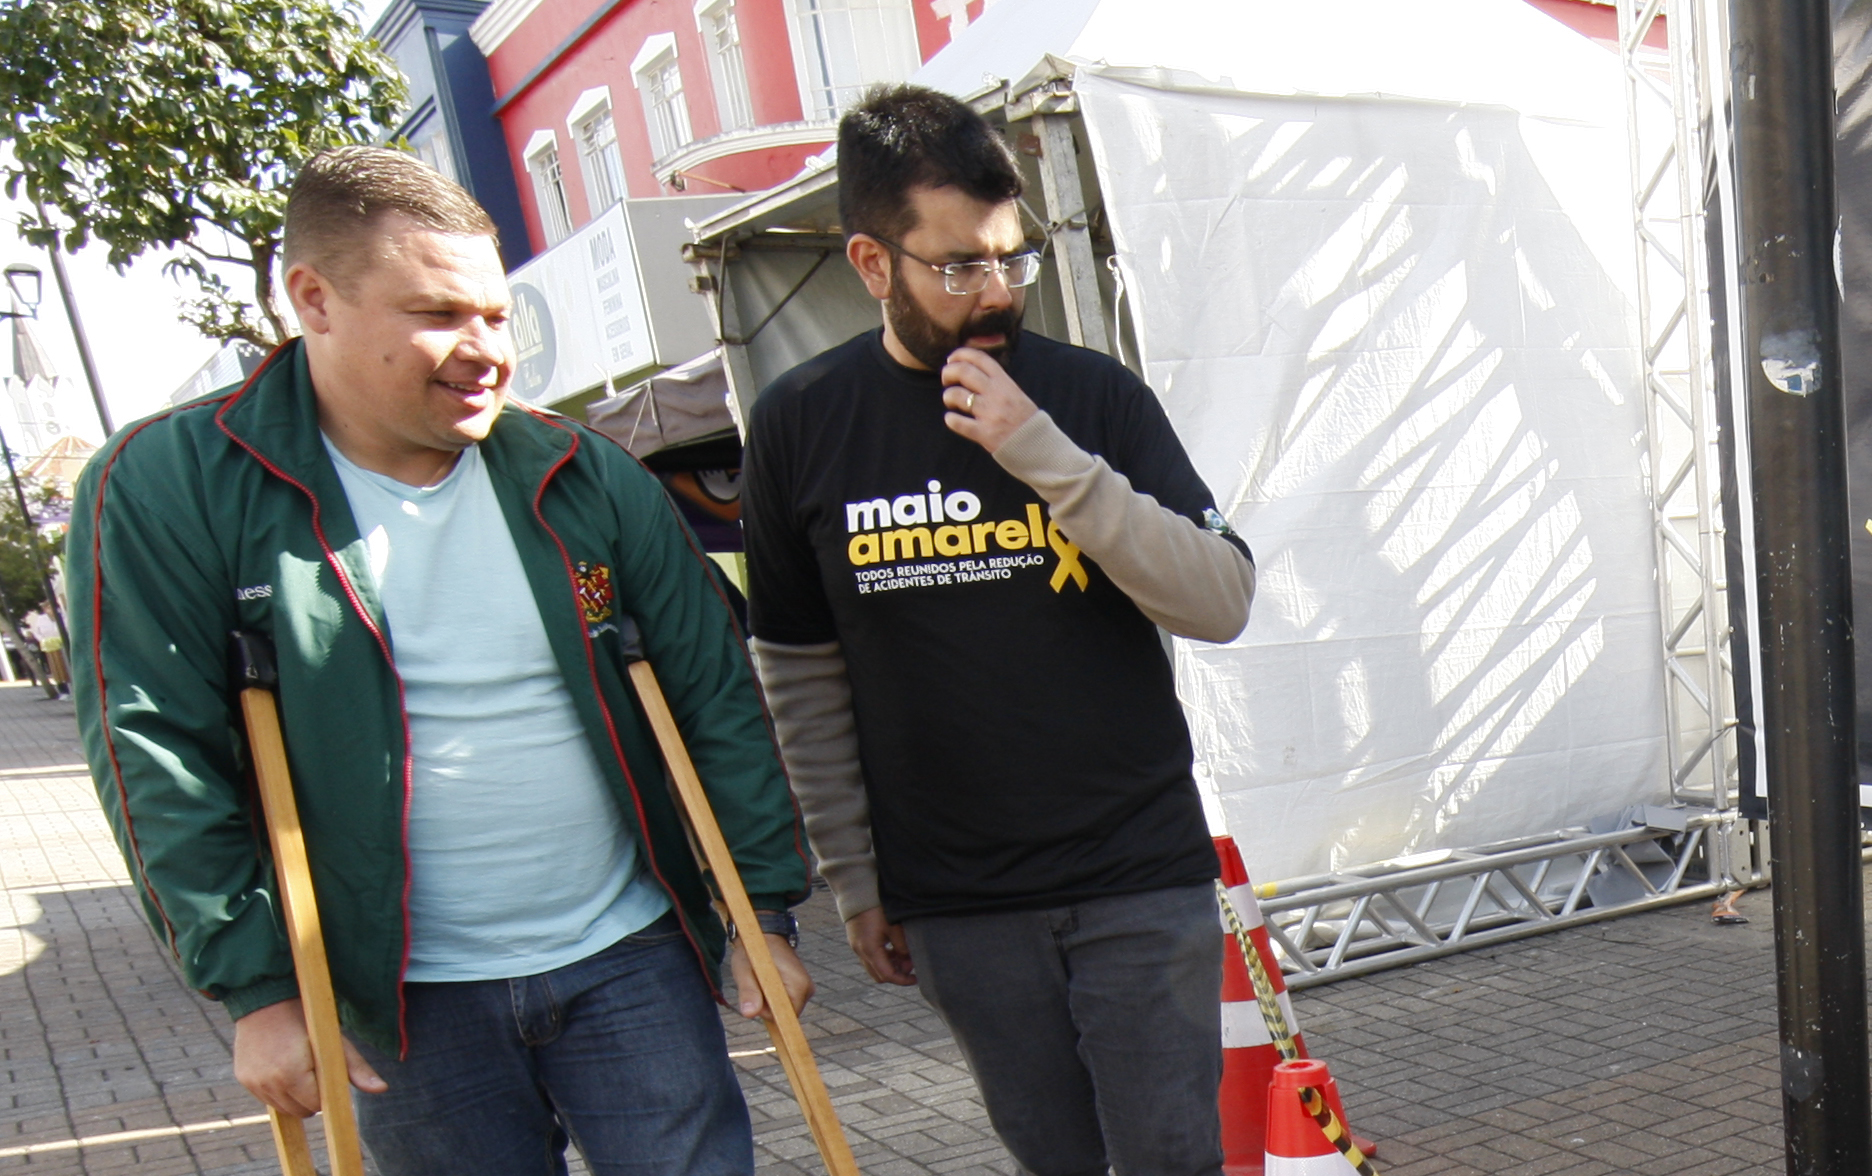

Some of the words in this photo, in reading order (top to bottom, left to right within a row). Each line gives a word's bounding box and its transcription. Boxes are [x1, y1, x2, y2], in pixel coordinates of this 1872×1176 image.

[846, 479, 981, 533] maio
[855, 568, 894, 582] TODOS
[896, 562, 956, 577] REUNIDOS
[959, 559, 986, 571] PELA
[989, 553, 1044, 568] REDUÇÃO
[858, 583, 871, 594] DE
[874, 576, 934, 592] ACIDENTES
[937, 574, 952, 585] DE
[954, 569, 1011, 583] TRÂNSITO
